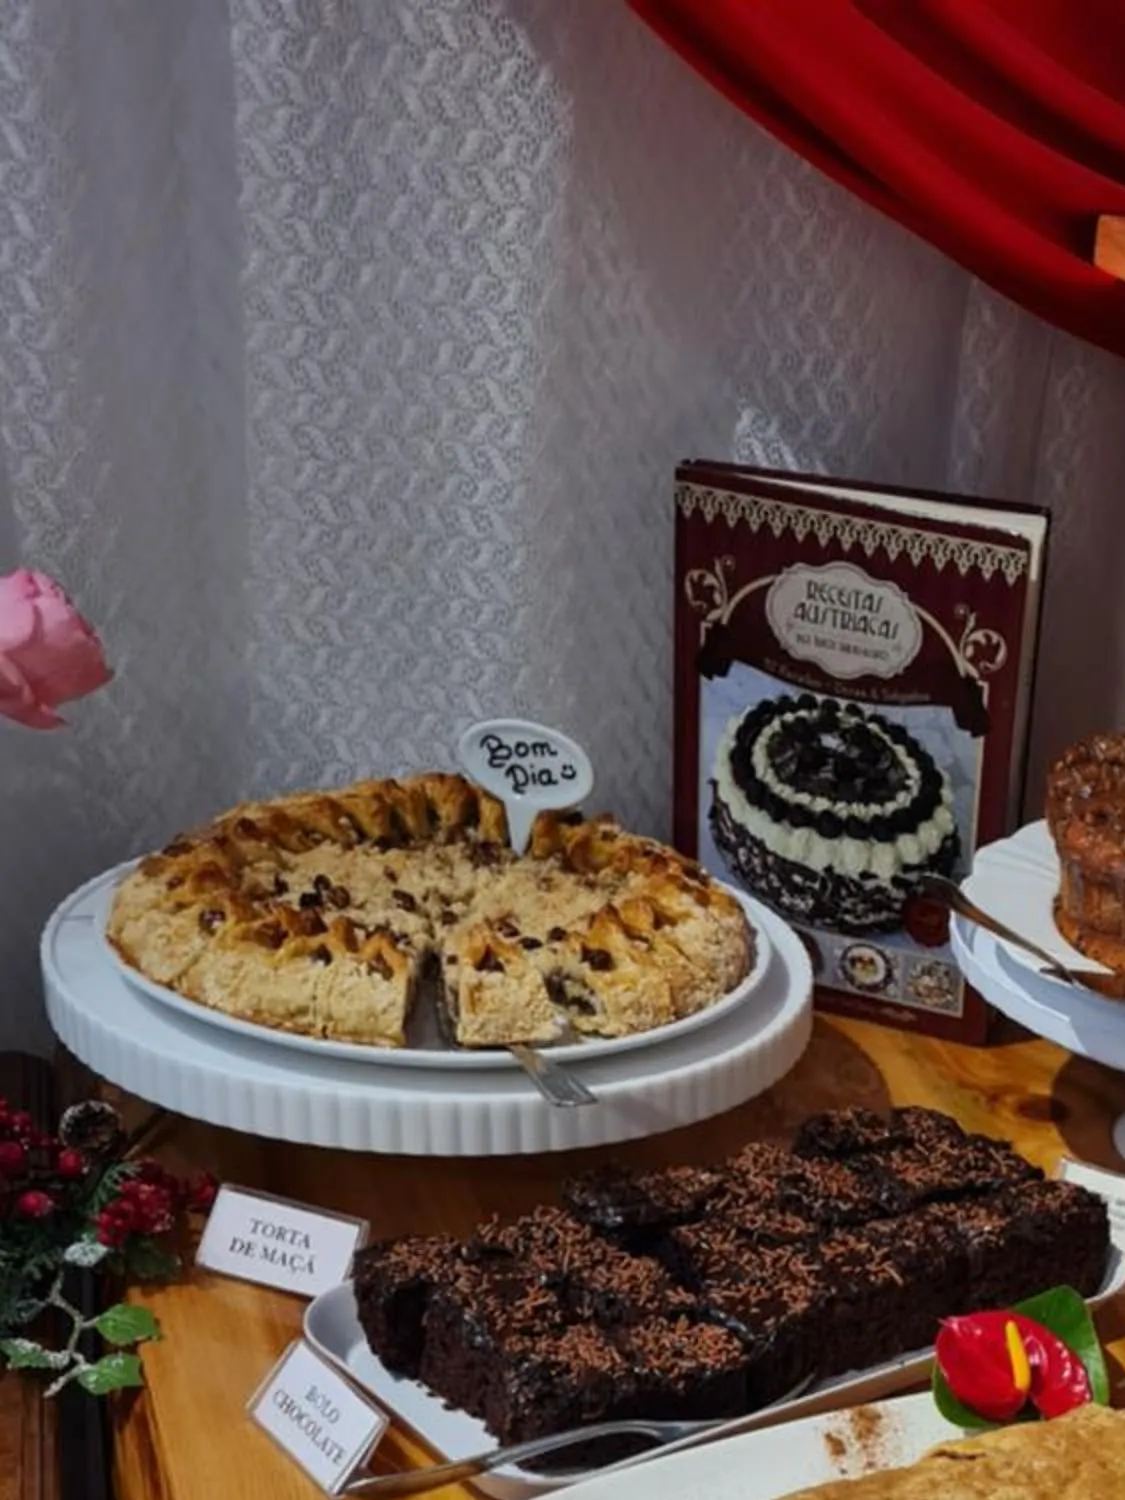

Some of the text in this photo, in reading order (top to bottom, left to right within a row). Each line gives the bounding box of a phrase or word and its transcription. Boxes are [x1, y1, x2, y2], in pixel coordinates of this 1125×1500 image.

[807, 580, 884, 614] RECEITAS
[480, 734, 558, 768] Bom
[505, 763, 559, 794] Dia
[229, 1237, 257, 1260] DE
[249, 1218, 312, 1249] TORTA
[304, 1385, 340, 1424] BOLO
[273, 1388, 346, 1466] CHOCOLATE
